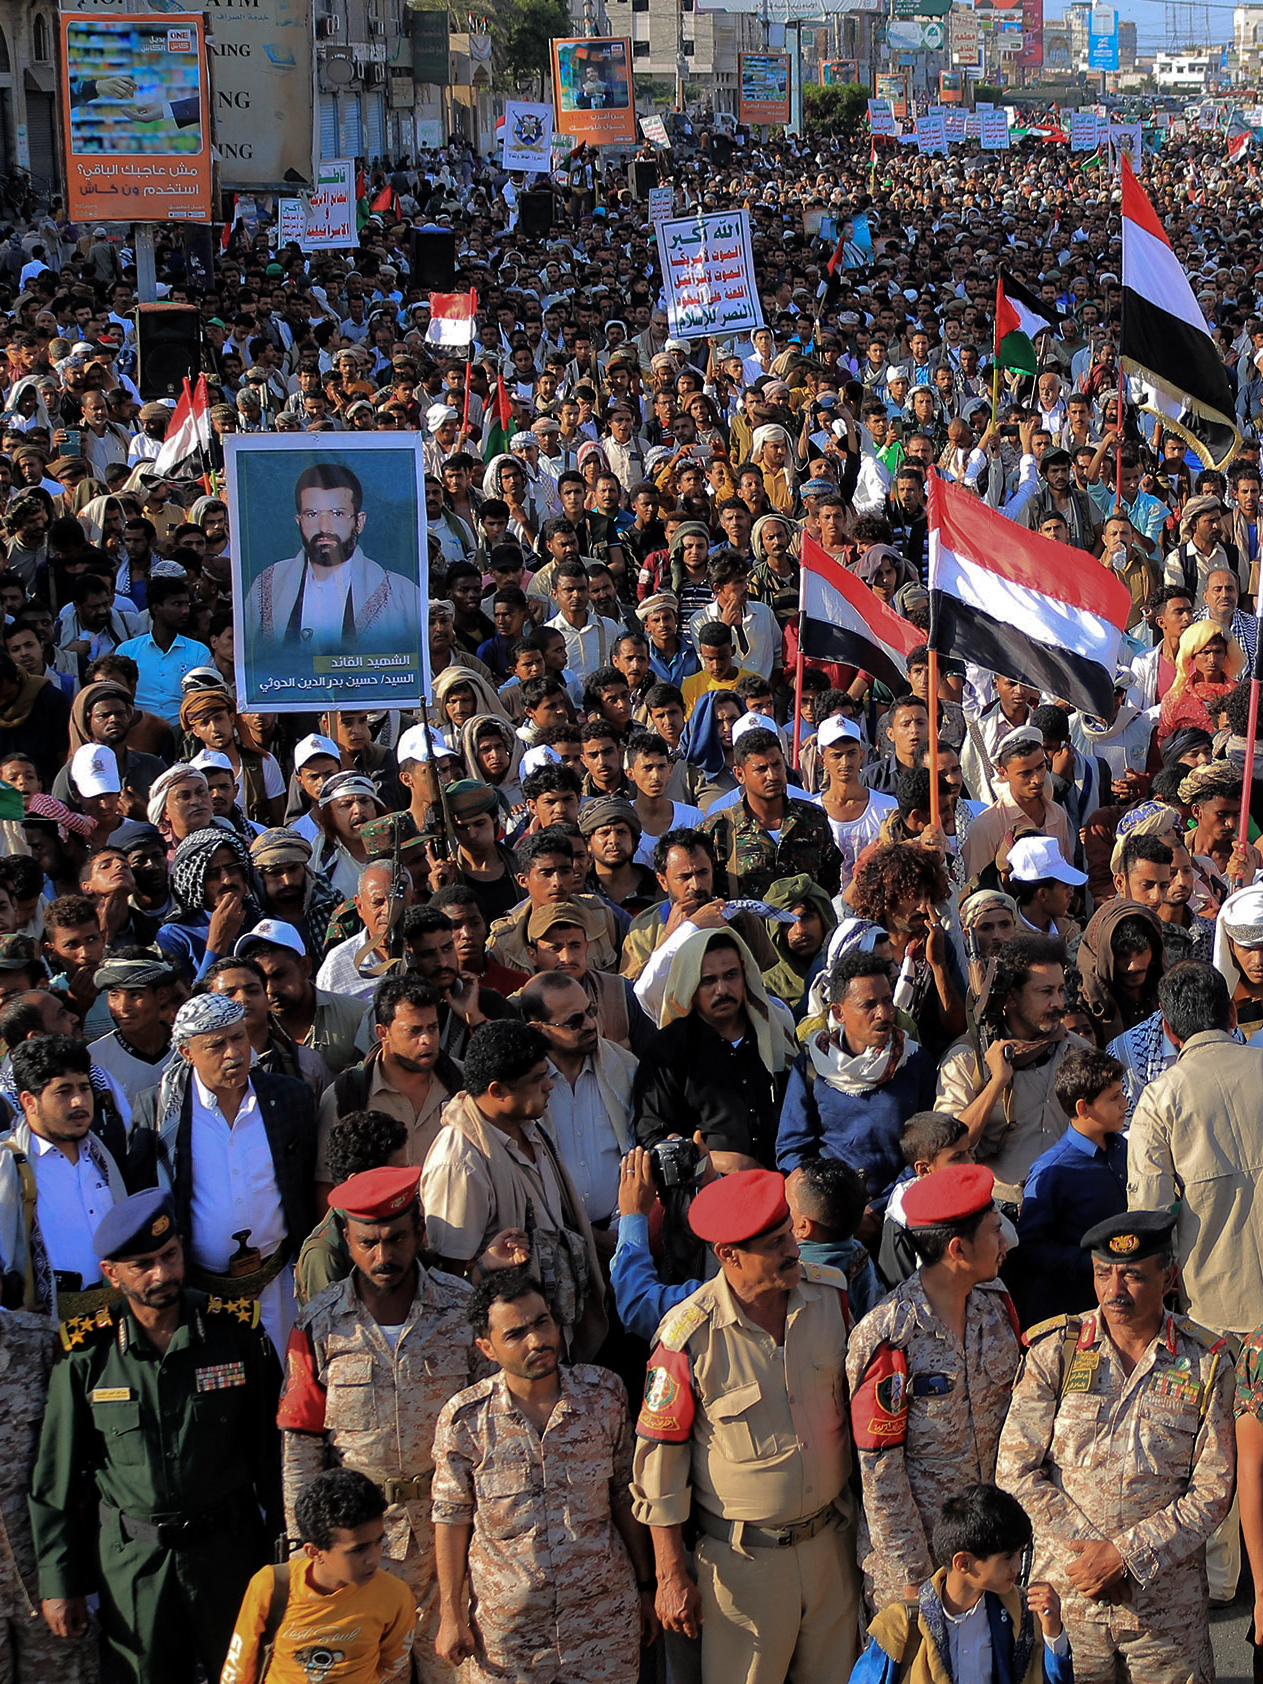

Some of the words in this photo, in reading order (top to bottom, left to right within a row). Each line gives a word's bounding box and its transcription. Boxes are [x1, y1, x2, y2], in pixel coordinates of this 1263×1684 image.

[219, 143, 253, 159] ING
[77, 163, 119, 181] الباقي؟
[121, 164, 166, 178] عاجبك
[169, 161, 198, 177] مش
[80, 181, 119, 196] كاش
[121, 184, 140, 196] ون
[143, 183, 199, 196] استخدم
[668, 222, 710, 251] أكبر
[713, 219, 740, 239] الله
[712, 244, 743, 263] الموت
[714, 264, 745, 283] الموت
[719, 303, 753, 327] النصر
[331, 656, 363, 668] القائد
[366, 655, 411, 669] الشهيد
[258, 677, 296, 693] الحوثي
[345, 676, 378, 687] حسين
